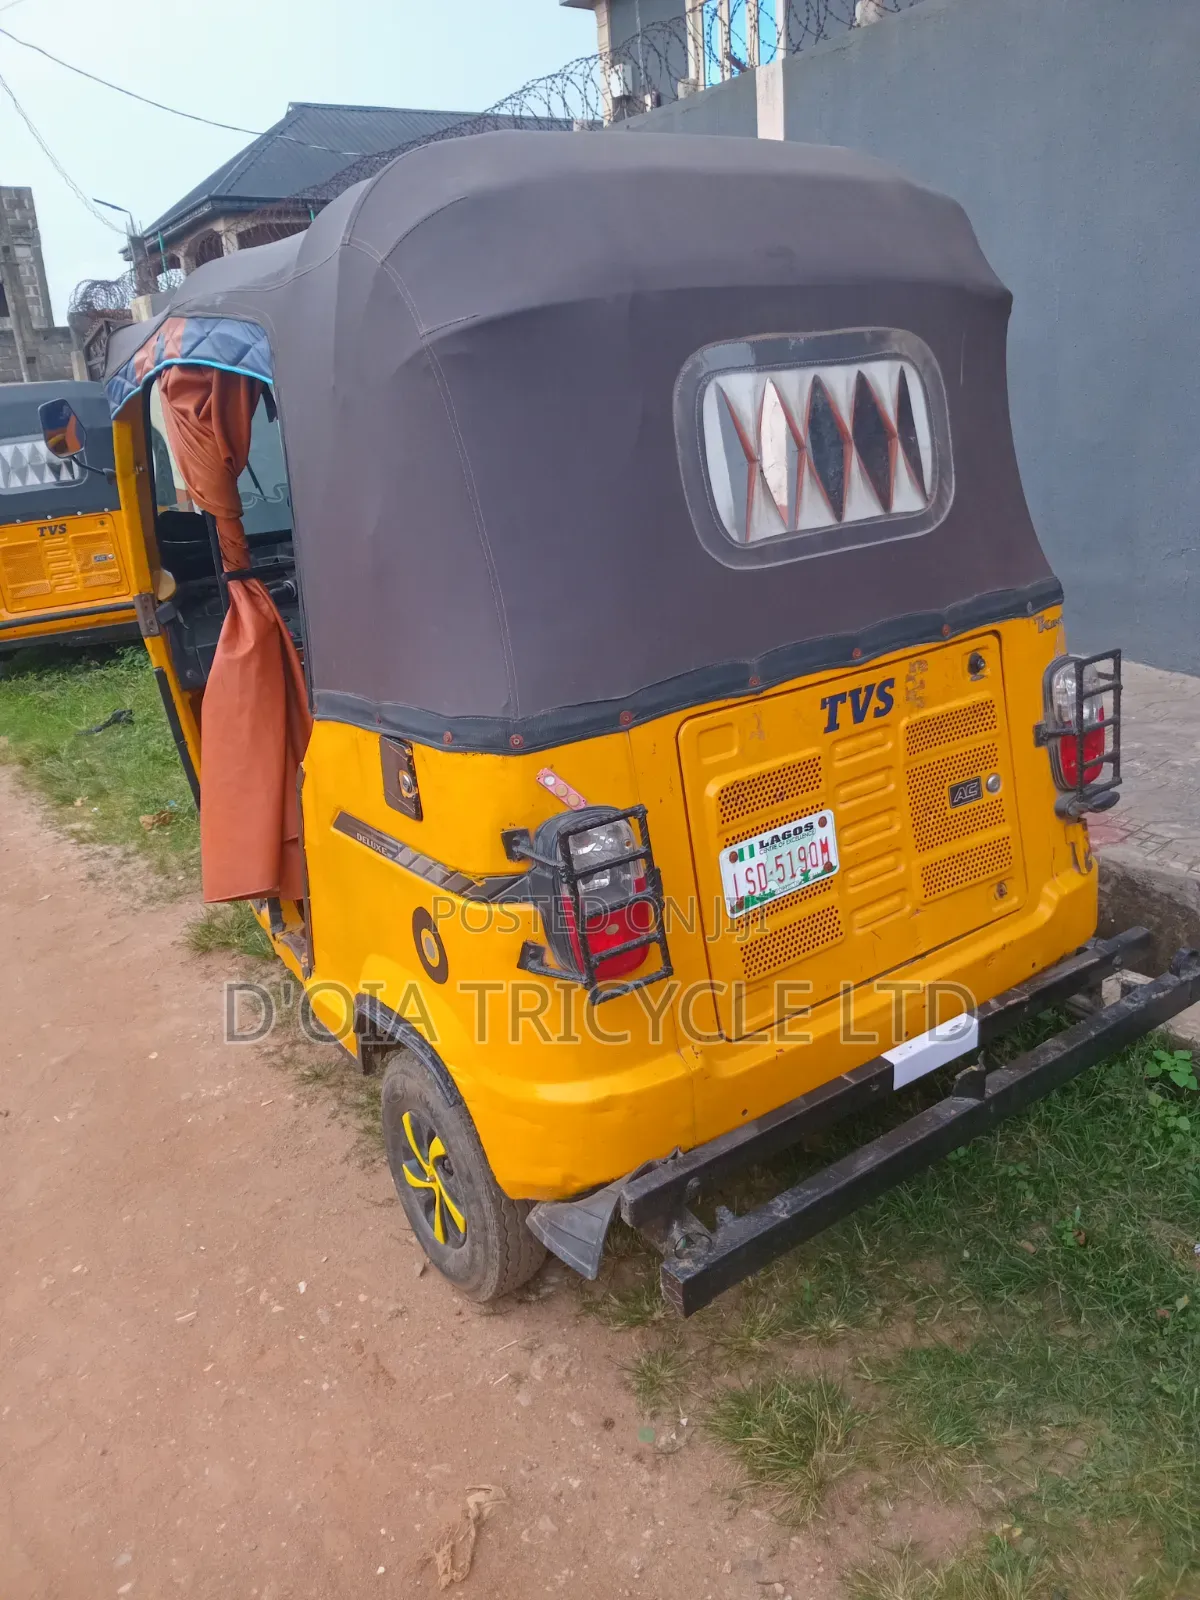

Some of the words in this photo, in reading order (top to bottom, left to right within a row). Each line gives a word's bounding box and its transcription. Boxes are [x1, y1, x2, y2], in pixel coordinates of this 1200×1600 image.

[37, 523, 67, 537] TVS
[820, 677, 896, 734] TVS
[953, 781, 978, 803] AC
[356, 832, 388, 855] DELUXE
[758, 821, 814, 850] LAGOS
[759, 843, 777, 855] CENTRE
[786, 828, 817, 845] EXCELLENCE
